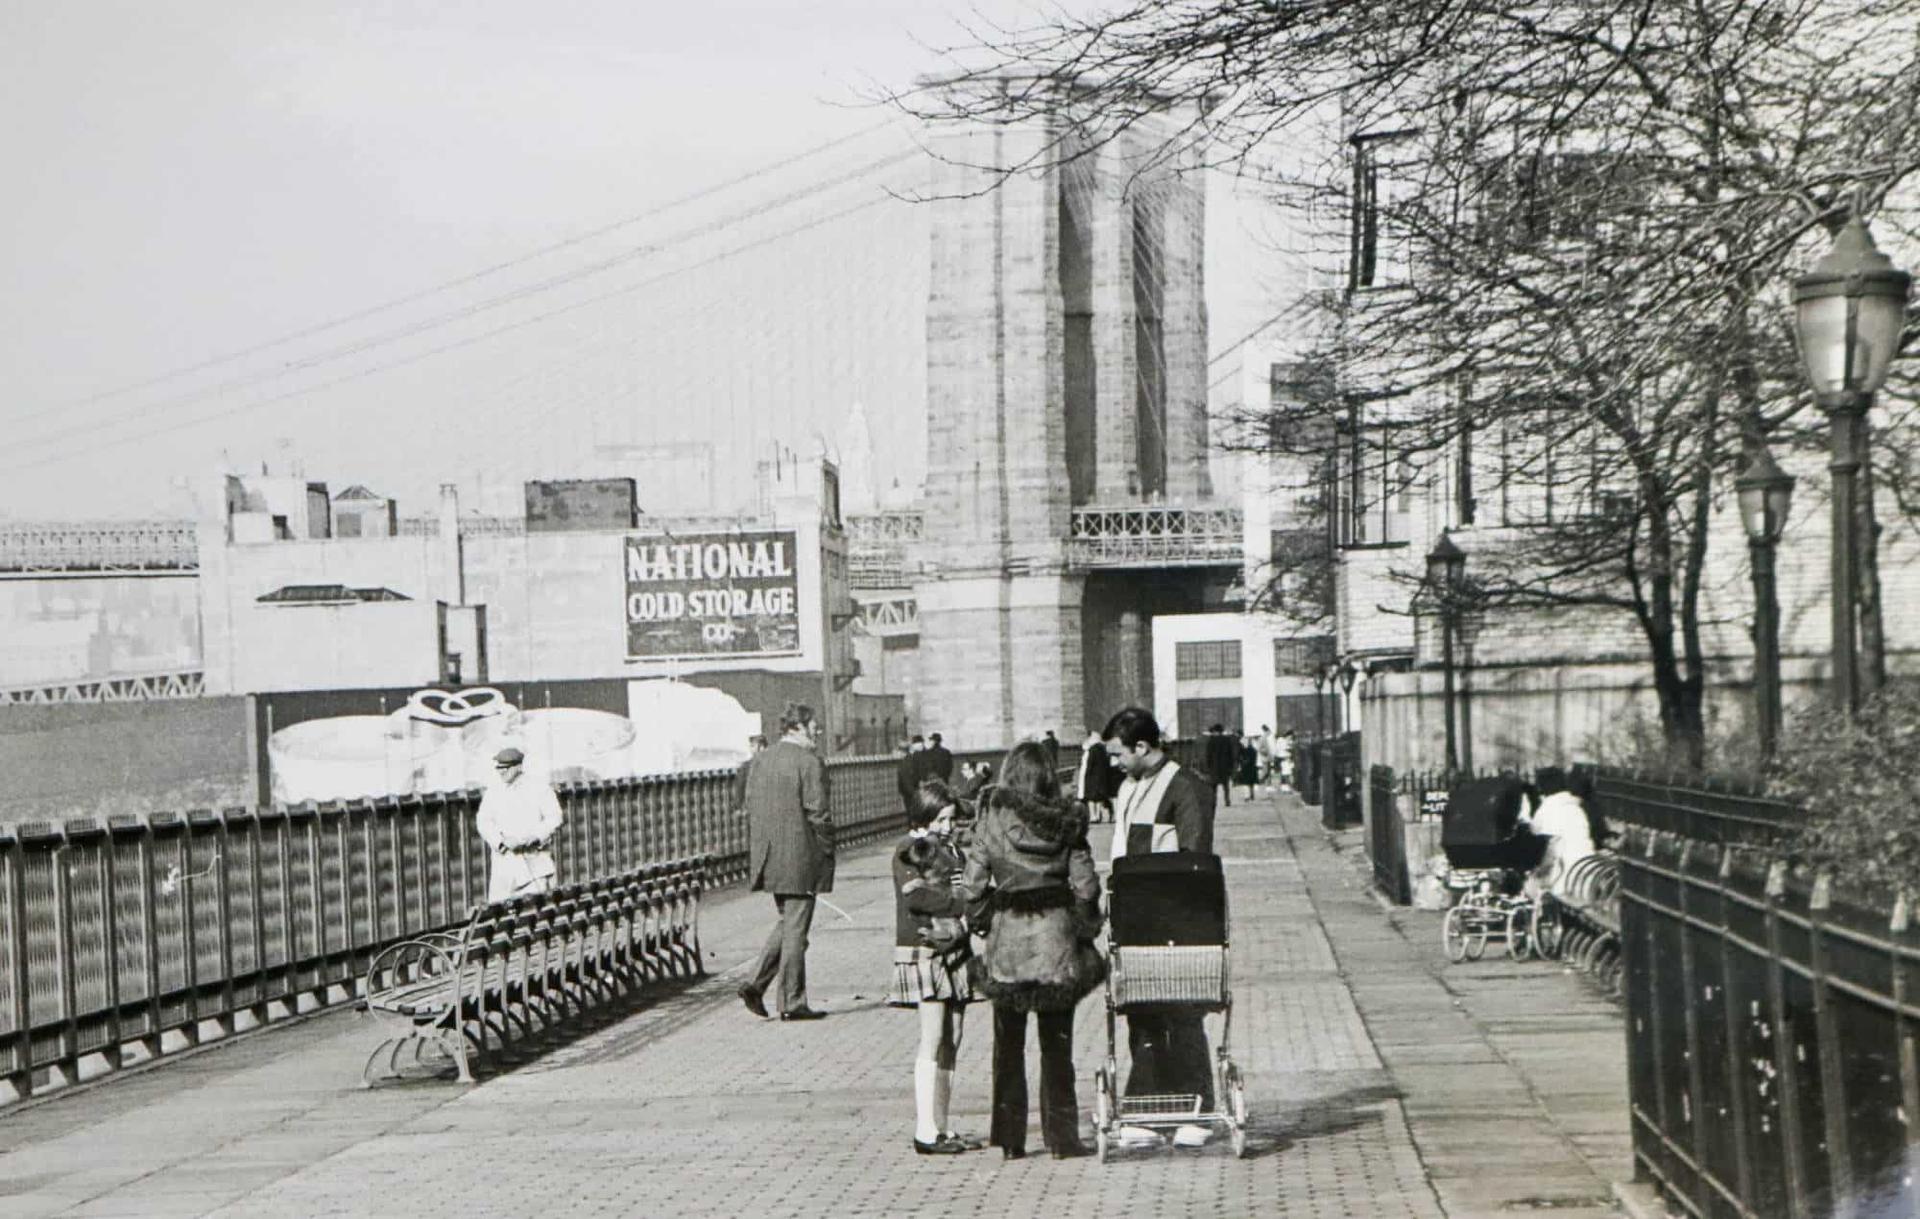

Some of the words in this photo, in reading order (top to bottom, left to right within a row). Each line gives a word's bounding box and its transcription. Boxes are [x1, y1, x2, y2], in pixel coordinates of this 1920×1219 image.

[628, 542, 792, 581] NATIONAL
[628, 592, 684, 621] COLD
[688, 587, 794, 617] STORAGE
